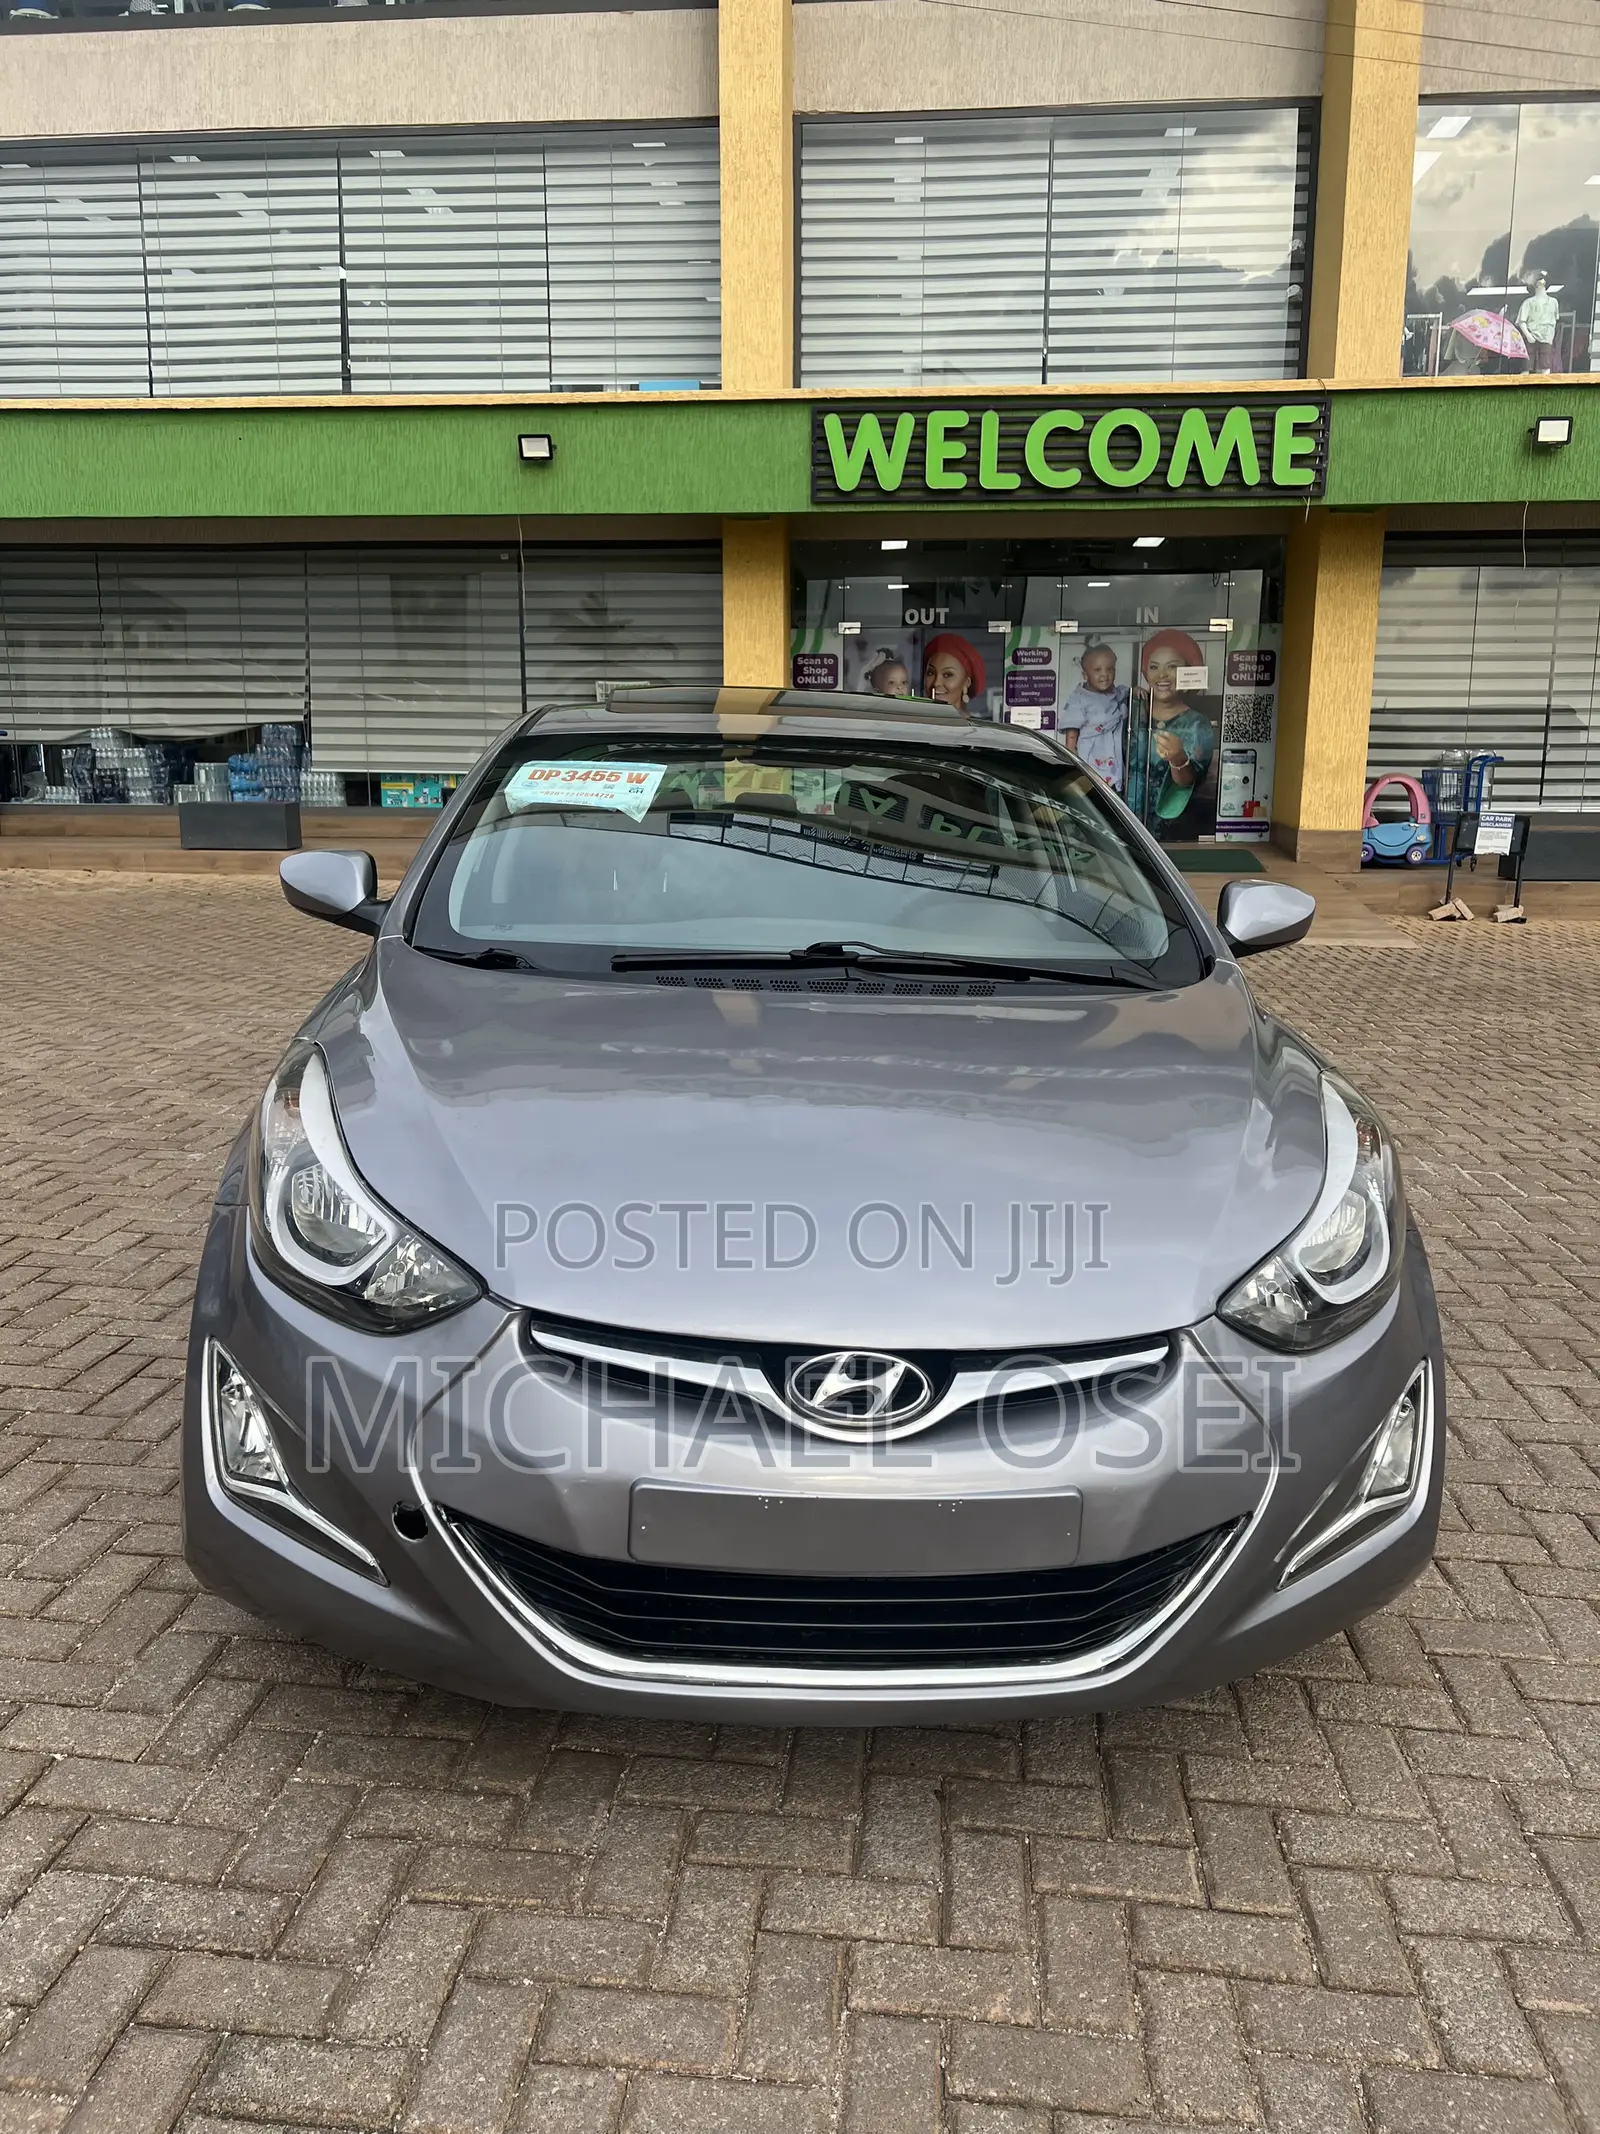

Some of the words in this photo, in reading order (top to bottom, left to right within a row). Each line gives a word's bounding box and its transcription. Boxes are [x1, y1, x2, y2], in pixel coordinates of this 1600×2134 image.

[823, 404, 1320, 492] WELCOME
[904, 607, 949, 625] OUT
[1136, 606, 1159, 624] IN
[797, 656, 821, 665] Scan
[823, 657, 834, 665] to
[1232, 653, 1258, 662] Scan
[1260, 653, 1272, 661] to
[802, 666, 829, 676] Shop
[1238, 663, 1265, 673] Shop
[796, 675, 834, 684] ONLINE
[1231, 672, 1271, 681] ONLINE
[528, 769, 561, 781] DP
[562, 770, 621, 782] 3455
[627, 772, 649, 784] W
